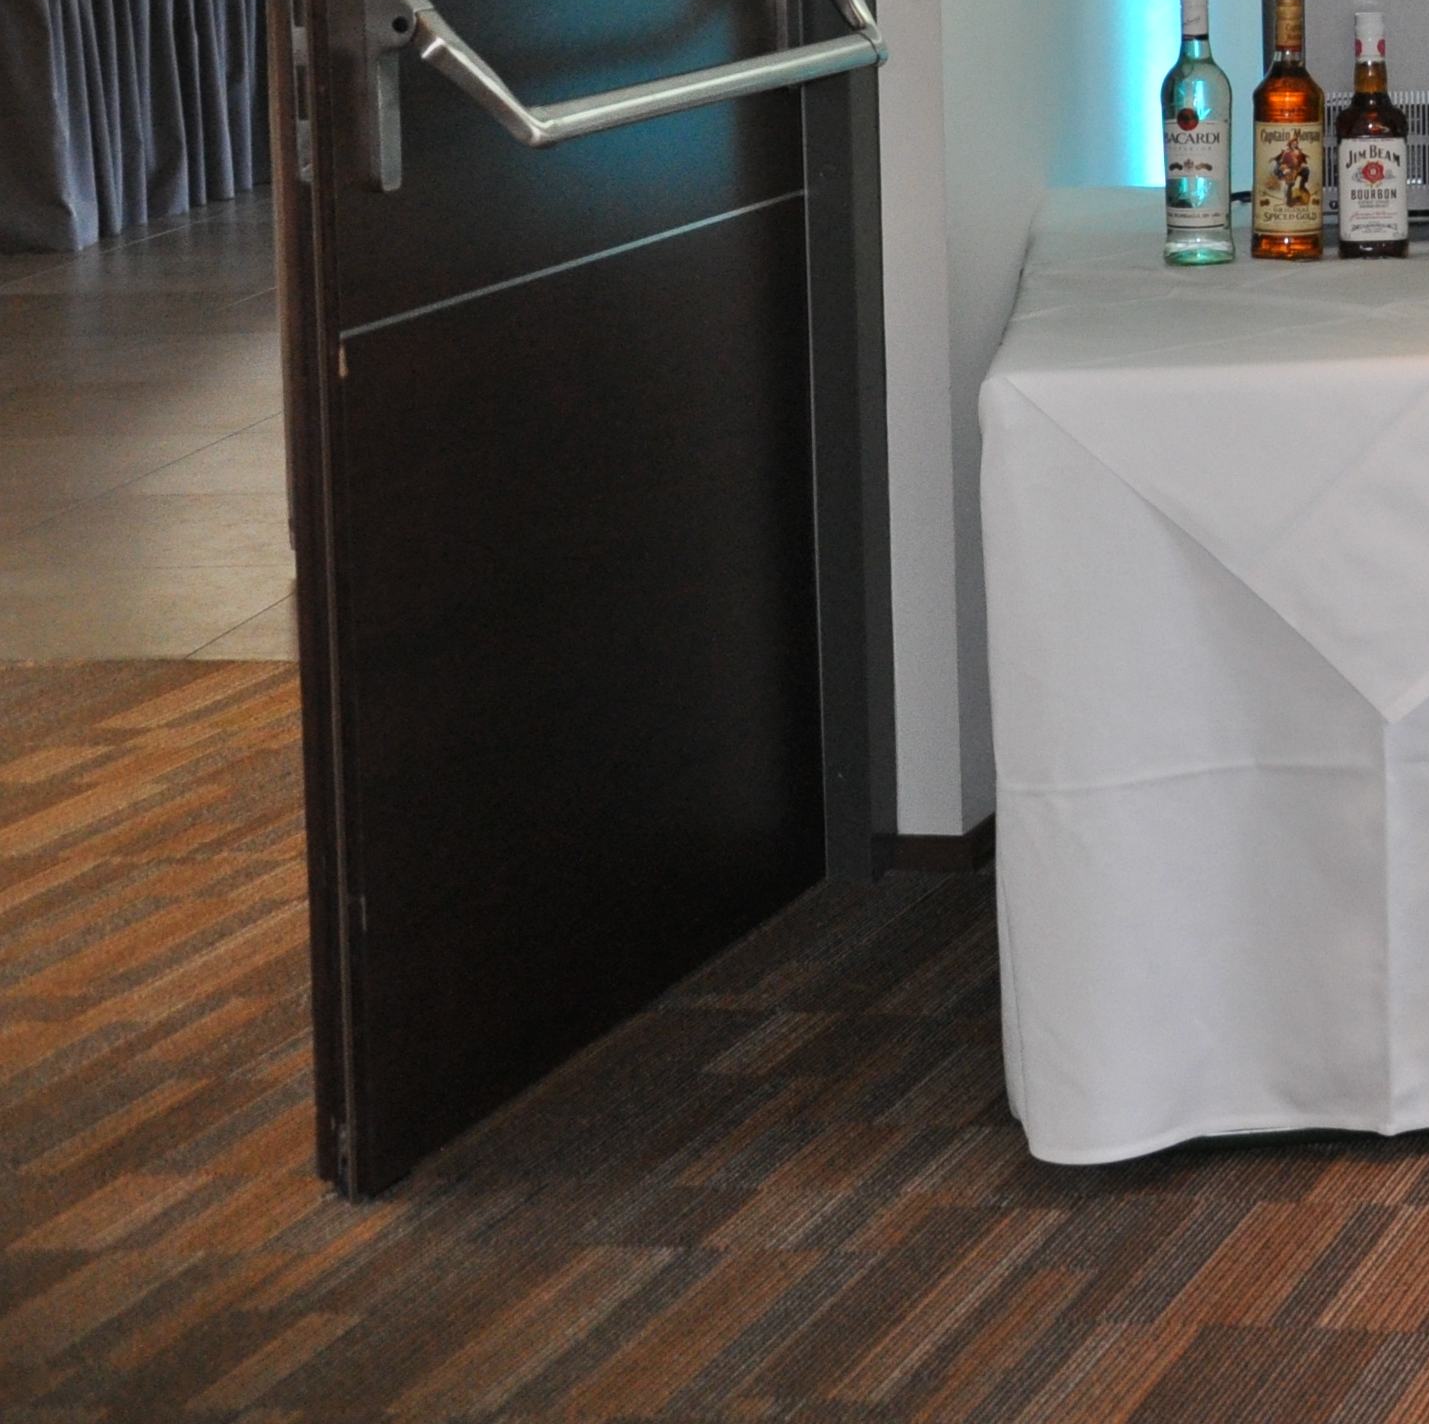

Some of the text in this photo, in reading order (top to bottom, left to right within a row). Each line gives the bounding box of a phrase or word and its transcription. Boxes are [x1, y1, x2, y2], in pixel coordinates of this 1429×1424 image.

[1260, 128, 1291, 144] Captain
[1346, 145, 1401, 169] JIM BEAM
[1351, 189, 1397, 200] BOURBON
